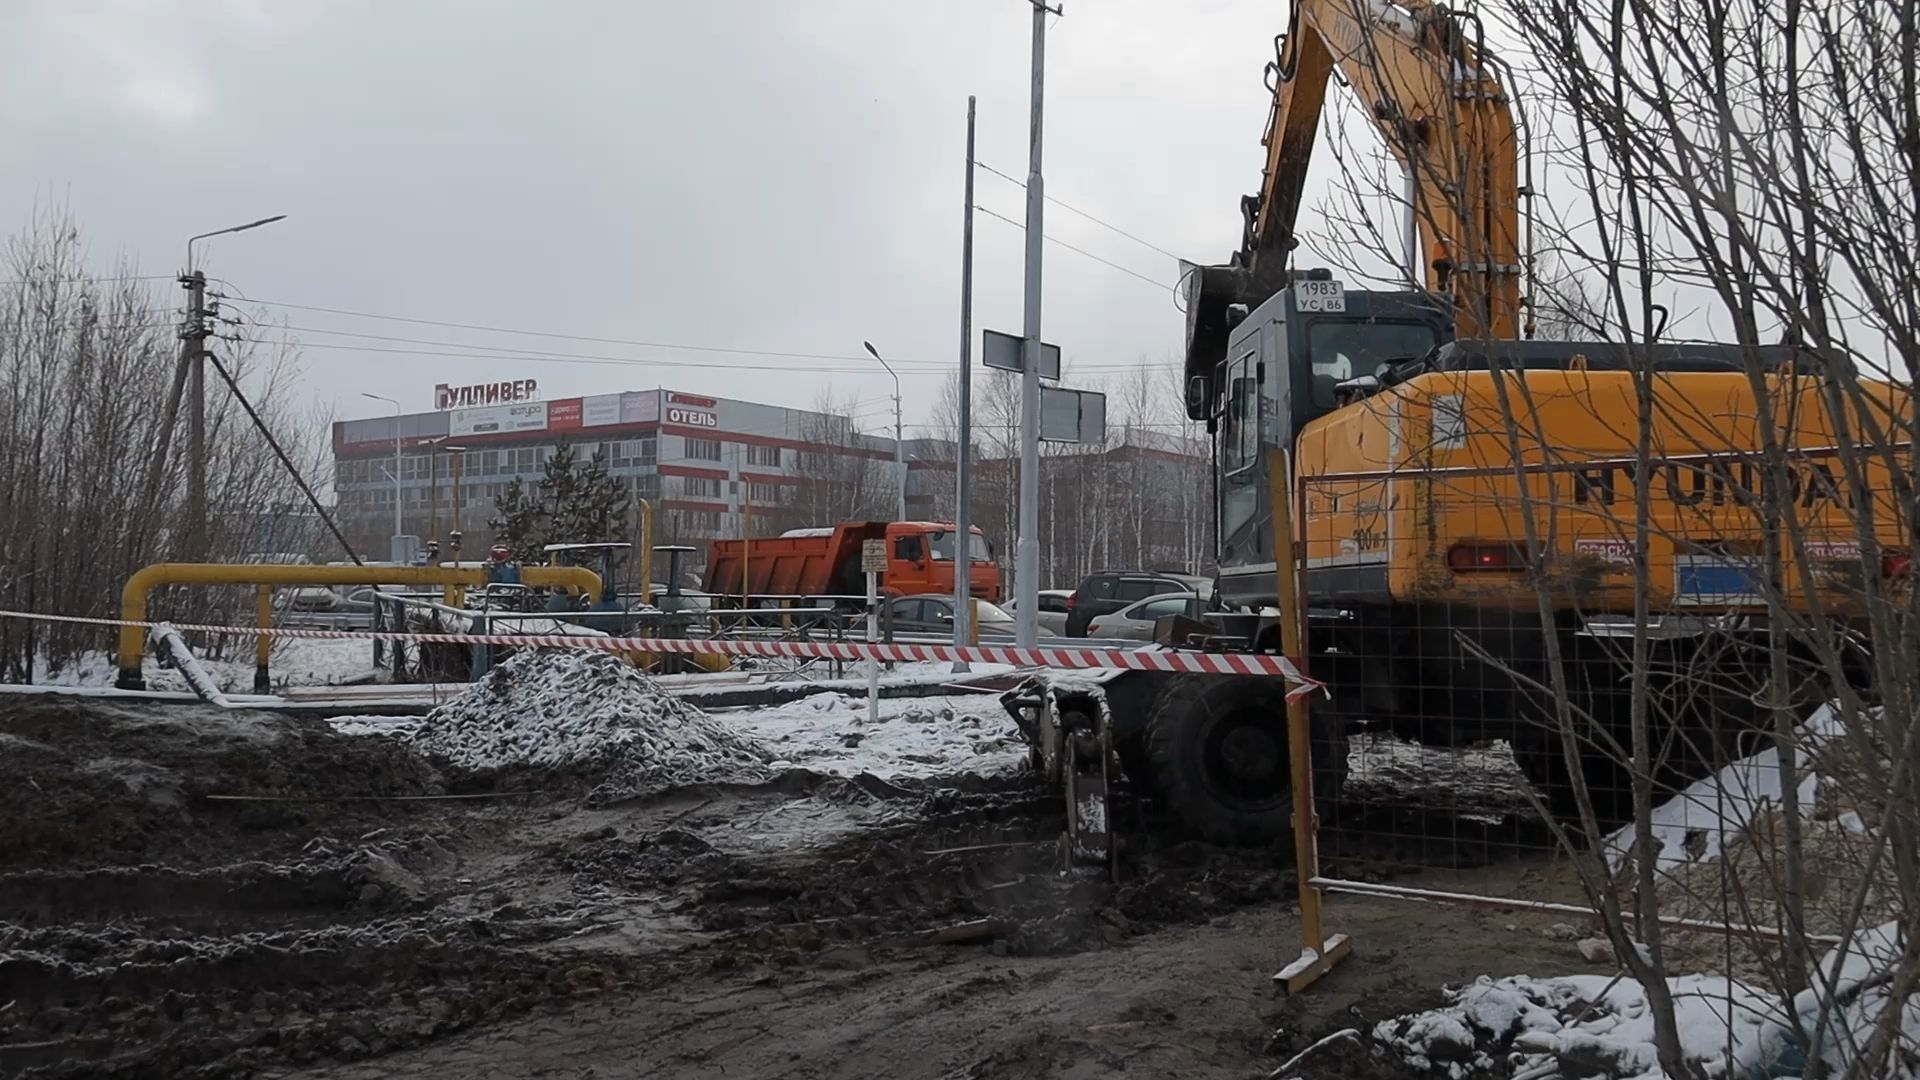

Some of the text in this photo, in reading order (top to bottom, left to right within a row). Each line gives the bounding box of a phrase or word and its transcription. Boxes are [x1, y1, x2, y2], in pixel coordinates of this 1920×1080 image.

[1302, 282, 1338, 296] 1983
[1327, 299, 1342, 310] 86
[434, 378, 537, 409] ГУЛЛИВЕР
[670, 409, 716, 426] ОТЕЛЬ
[1574, 459, 1864, 509] HYUNDA
